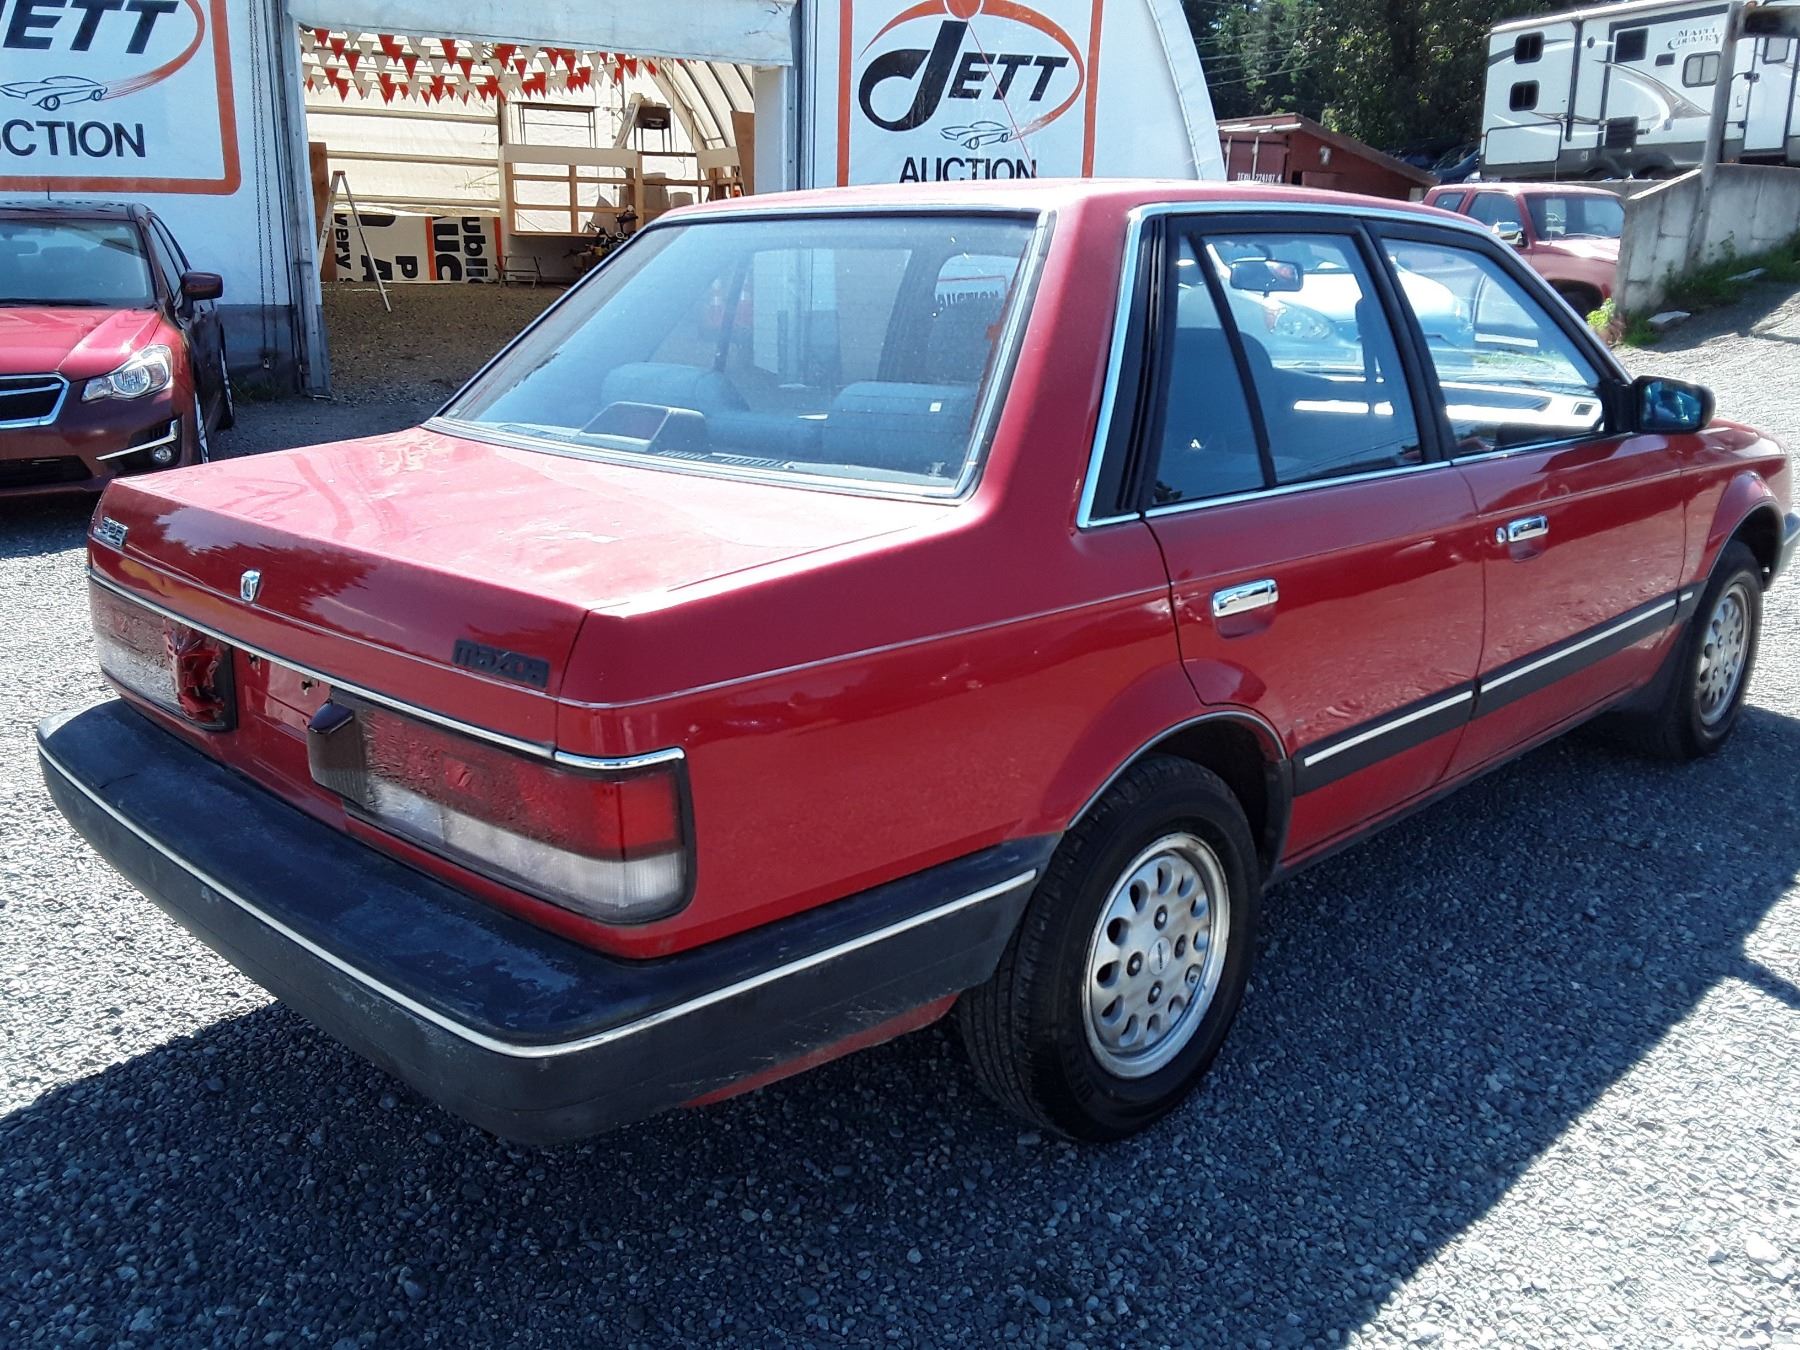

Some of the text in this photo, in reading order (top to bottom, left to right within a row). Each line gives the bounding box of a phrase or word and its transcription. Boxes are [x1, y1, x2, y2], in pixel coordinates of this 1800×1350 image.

[0, 0, 178, 54] ETT
[858, 20, 1069, 132] JETT
[0, 119, 146, 157] CTION
[899, 157, 1037, 183] AUCTION
[432, 216, 463, 281] UC
[461, 217, 488, 283] ubli
